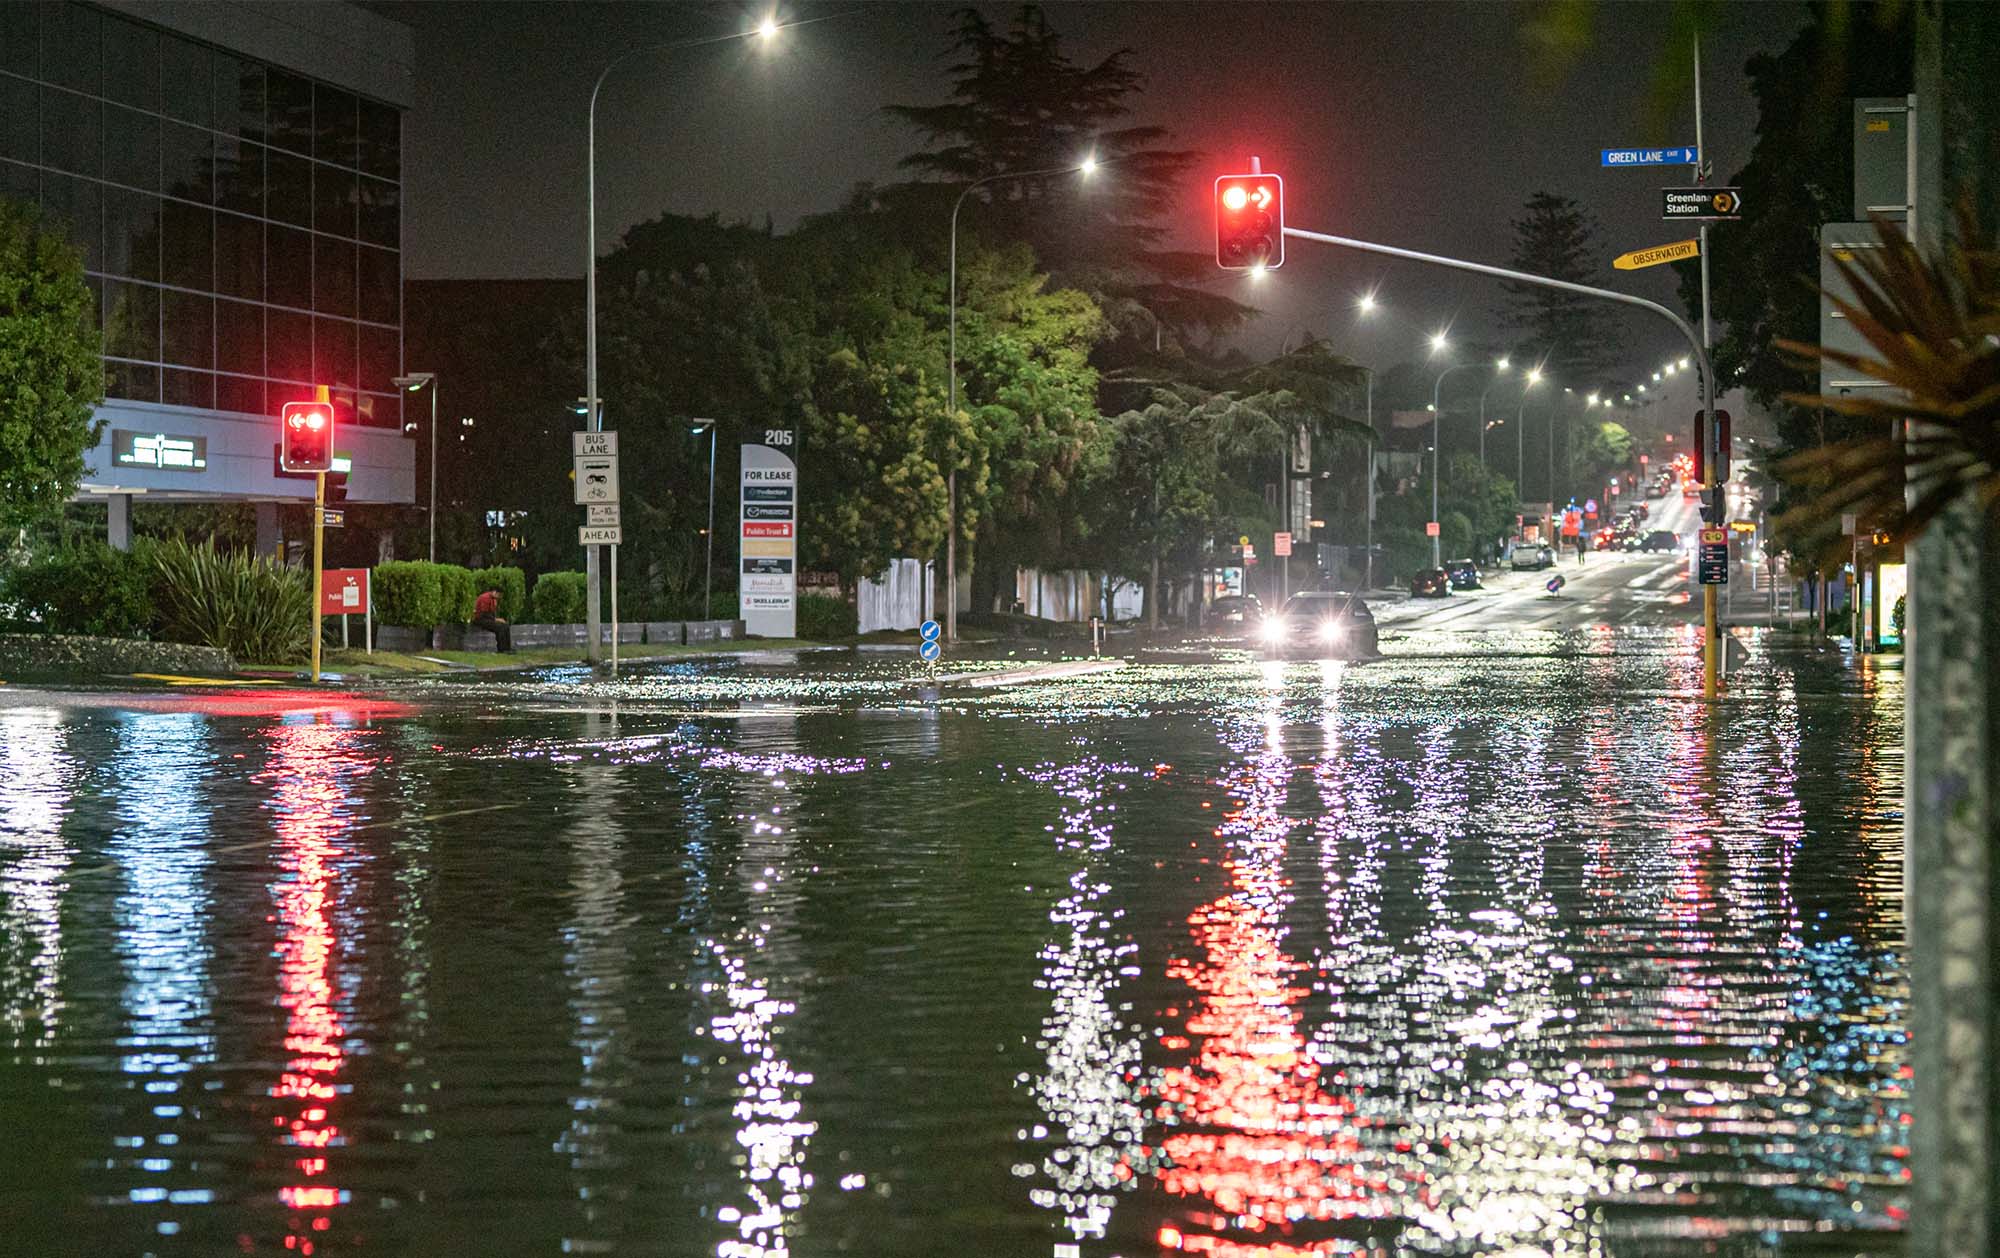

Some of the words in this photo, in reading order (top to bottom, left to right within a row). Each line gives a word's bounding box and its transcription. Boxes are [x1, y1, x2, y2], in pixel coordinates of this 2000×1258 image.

[1608, 152, 1637, 163] GREEN
[1639, 151, 1663, 162] LANE
[1666, 204, 1699, 213] Station
[1632, 244, 1692, 265] OBSERVATORY
[585, 434, 606, 444] BUS
[764, 429, 793, 446] 205
[582, 444, 609, 454] LANE
[744, 471, 762, 480] FOR
[764, 471, 792, 480] LEASE
[583, 530, 617, 540] AHEAD
